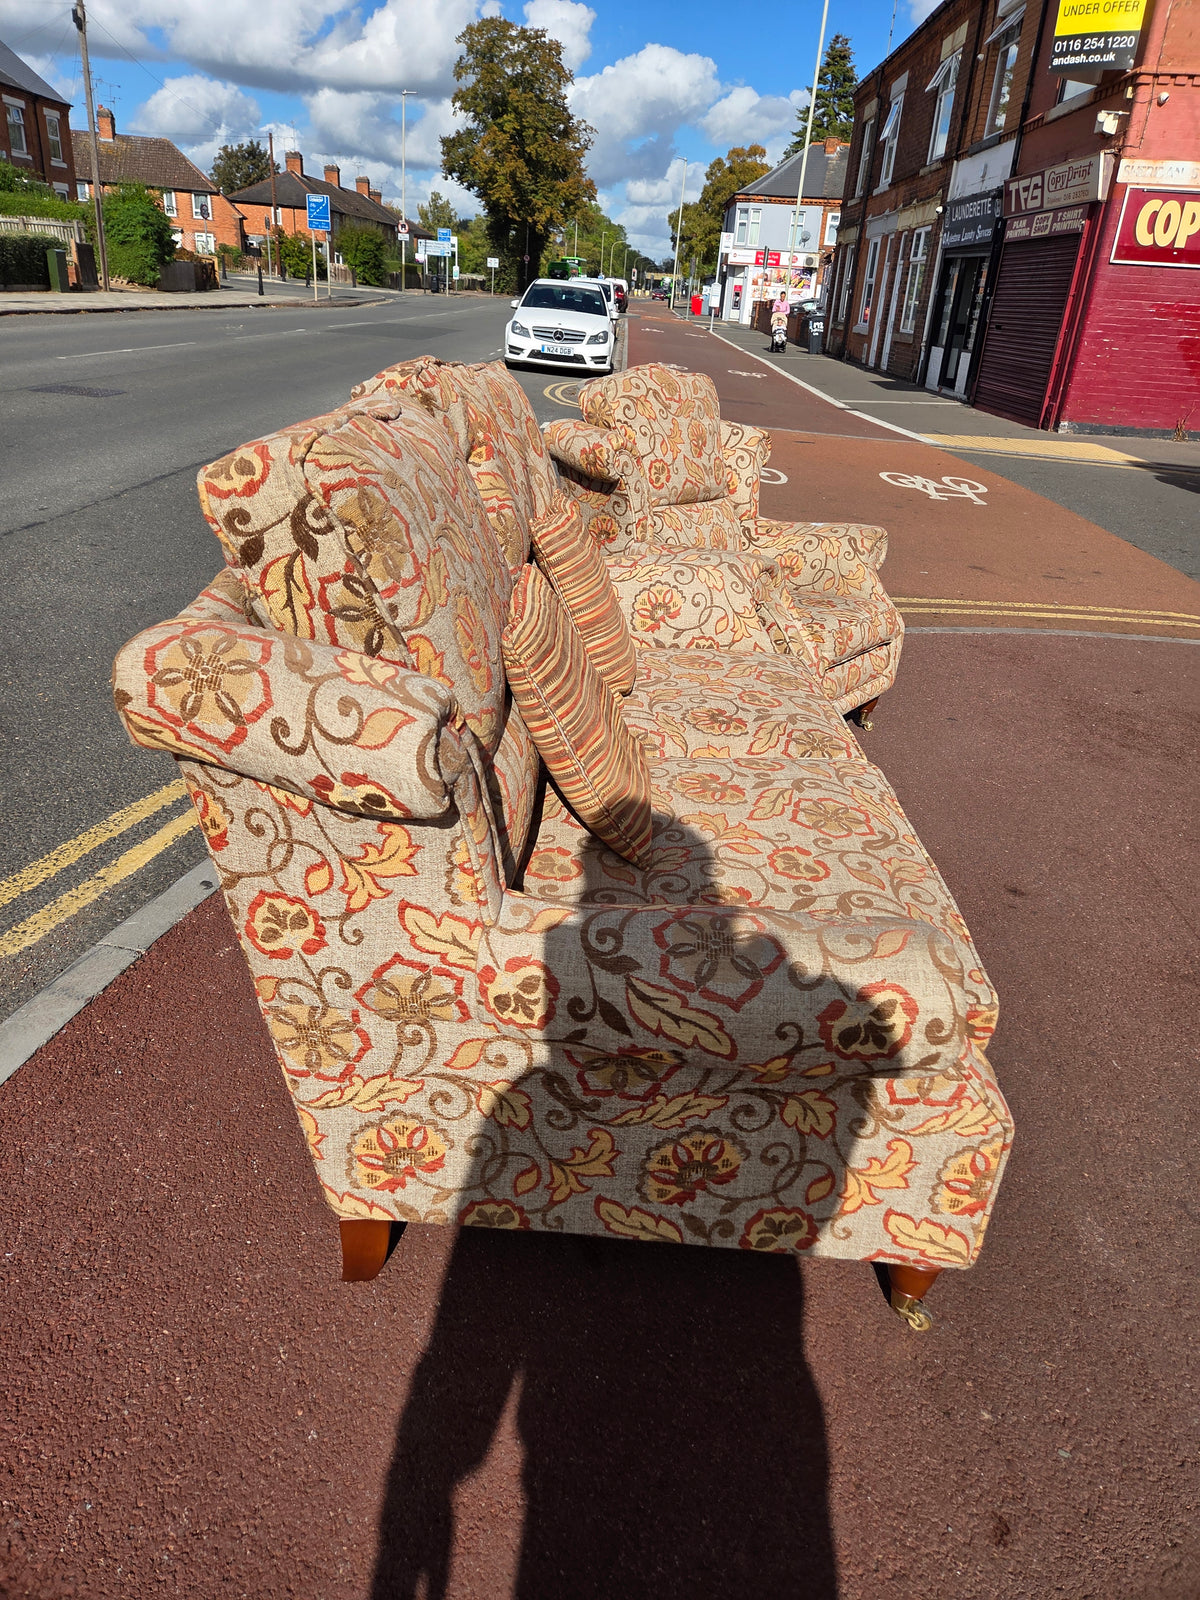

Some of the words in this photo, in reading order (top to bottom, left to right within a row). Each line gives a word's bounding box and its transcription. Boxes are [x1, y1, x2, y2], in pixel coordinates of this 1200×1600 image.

[1063, 2, 1100, 17] UNDER
[1103, 0, 1140, 13] OFFER
[1054, 39, 1081, 53] 0116
[1083, 37, 1105, 50] 254
[1107, 35, 1135, 48] 1220
[1052, 51, 1116, 66] andash.co.uk
[1009, 175, 1042, 212] TFG
[951, 198, 992, 221] LAUNDERETTE
[1062, 209, 1083, 220] SHIRT
[1012, 219, 1027, 229] PLAN
[1035, 215, 1050, 225] COPY
[1052, 219, 1083, 232] PRINTING
[975, 224, 993, 240] Services
[1005, 227, 1030, 239] PRINTING
[1033, 224, 1049, 234] SHOP
